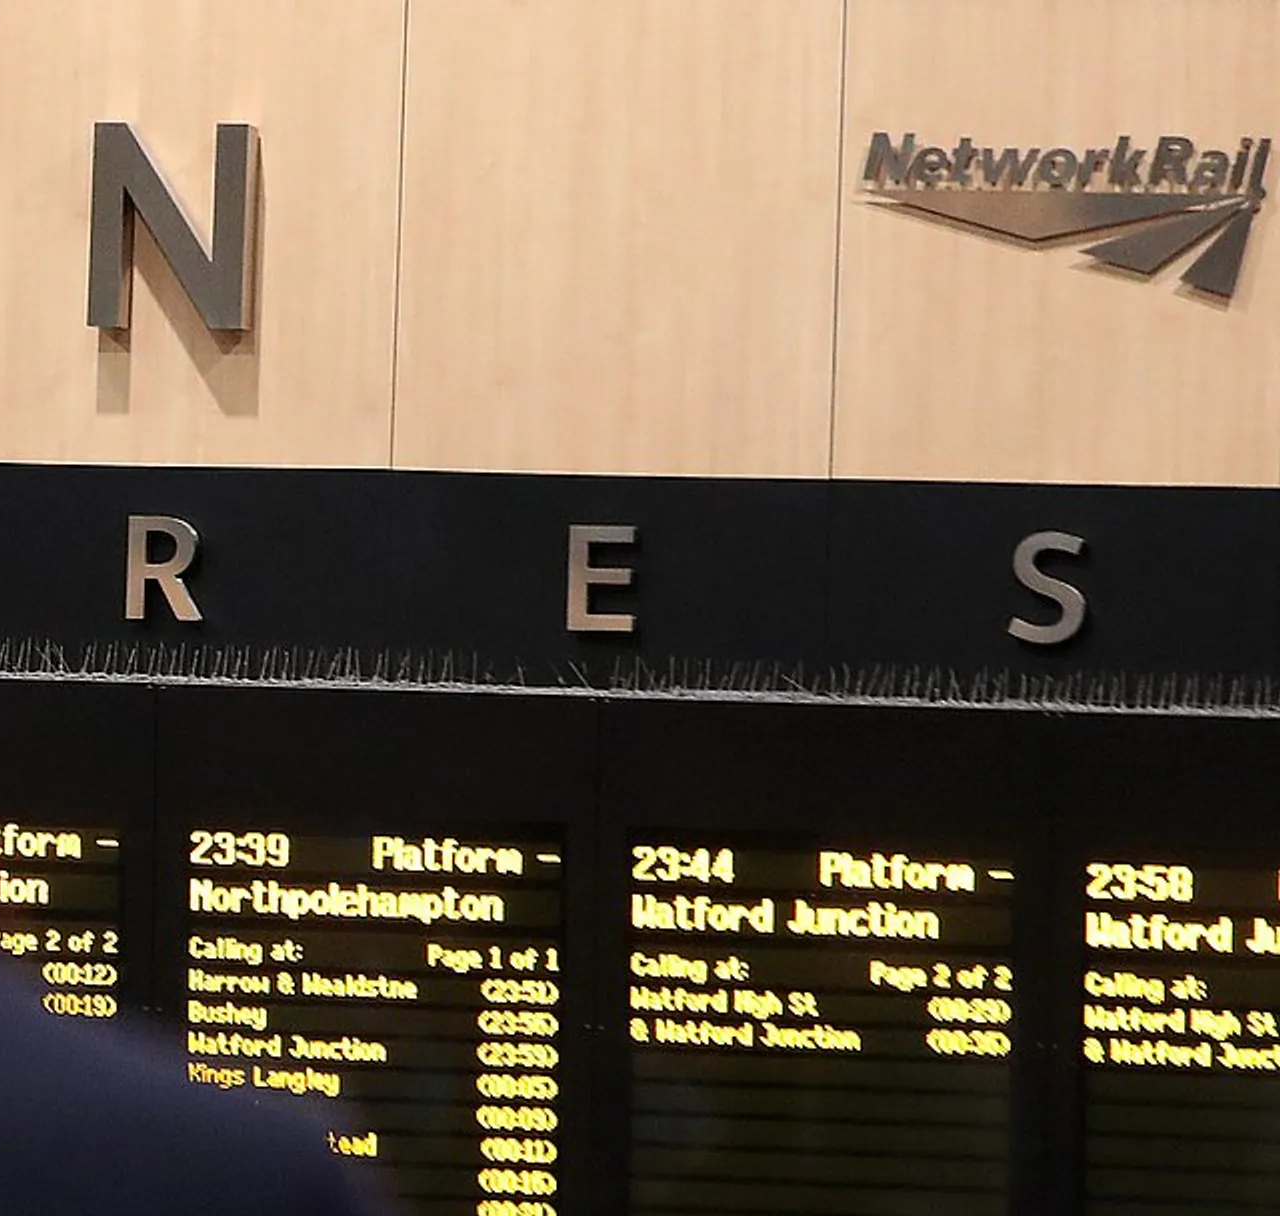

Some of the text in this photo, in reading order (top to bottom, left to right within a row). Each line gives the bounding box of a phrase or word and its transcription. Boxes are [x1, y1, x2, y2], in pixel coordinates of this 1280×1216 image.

[189, 830, 524, 875] 23:39 Platform
[631, 845, 975, 892] 23:44 Platform
[1086, 863, 1194, 903] 23:58
[189, 878, 505, 924] Northpolehampton
[630, 894, 940, 940] Watford Junction
[44, 930, 62, 951] 2
[67, 930, 96, 953] of
[102, 930, 119, 954] 2
[1085, 912, 1234, 953] Watford
[188, 936, 264, 964] Calling
[427, 943, 484, 973] Page
[489, 945, 504, 968] 1
[510, 947, 540, 971] of
[546, 948, 559, 972] 1
[630, 952, 708, 984] Calling
[869, 960, 928, 992] Page
[933, 963, 952, 988] 2
[956, 964, 990, 991] of
[993, 965, 1013, 992] 2
[188, 968, 271, 995] Harrow
[277, 973, 295, 995] &
[1084, 971, 1165, 1004] Calling
[188, 1000, 268, 1030] Bushey
[629, 986, 728, 1013] Watford
[188, 1031, 388, 1063] Watford Junction
[655, 1020, 753, 1046] Watford
[759, 1022, 862, 1051] Junction
[188, 1063, 342, 1097] Kings Langley
